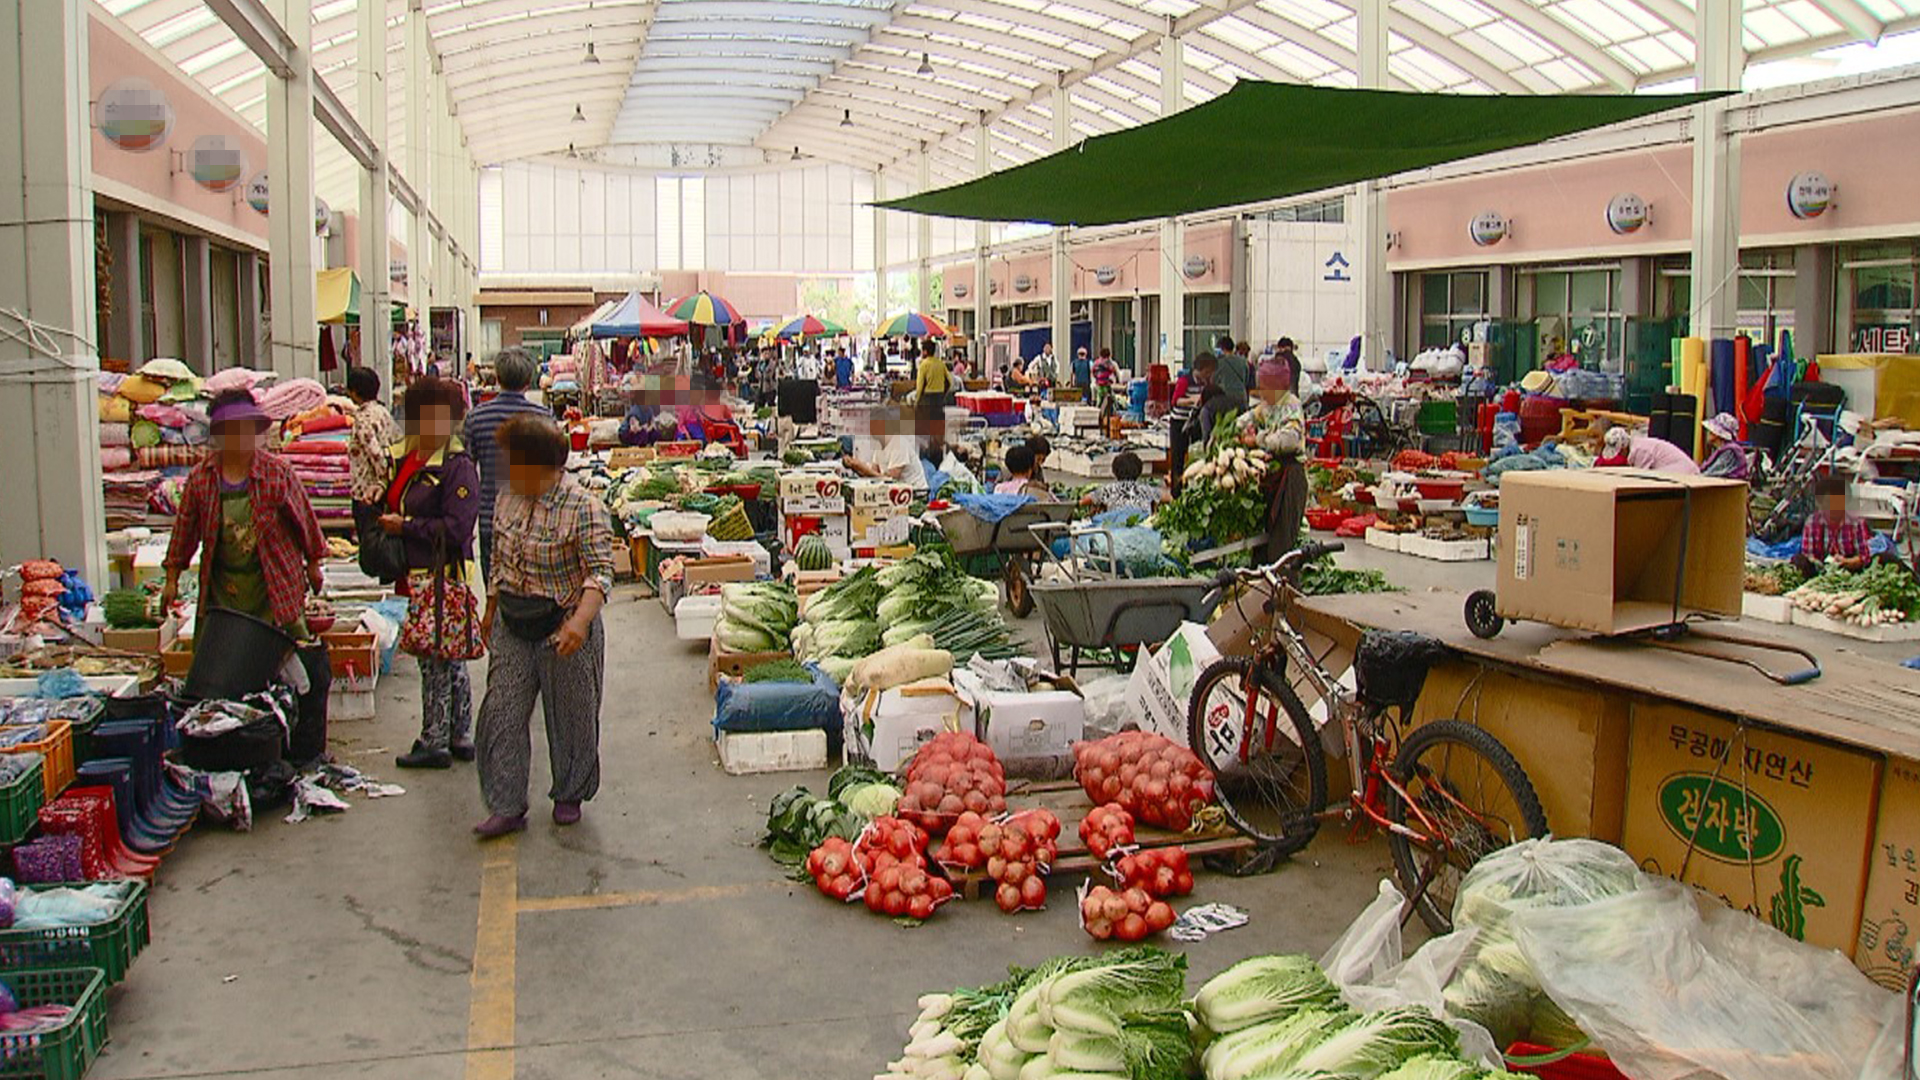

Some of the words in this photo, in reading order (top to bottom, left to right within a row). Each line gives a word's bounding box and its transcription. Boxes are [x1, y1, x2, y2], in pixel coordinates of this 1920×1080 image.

[1324, 251, 1351, 281] 소
[1856, 327, 1911, 354] 세탁
[1739, 745, 1813, 788] 자연산
